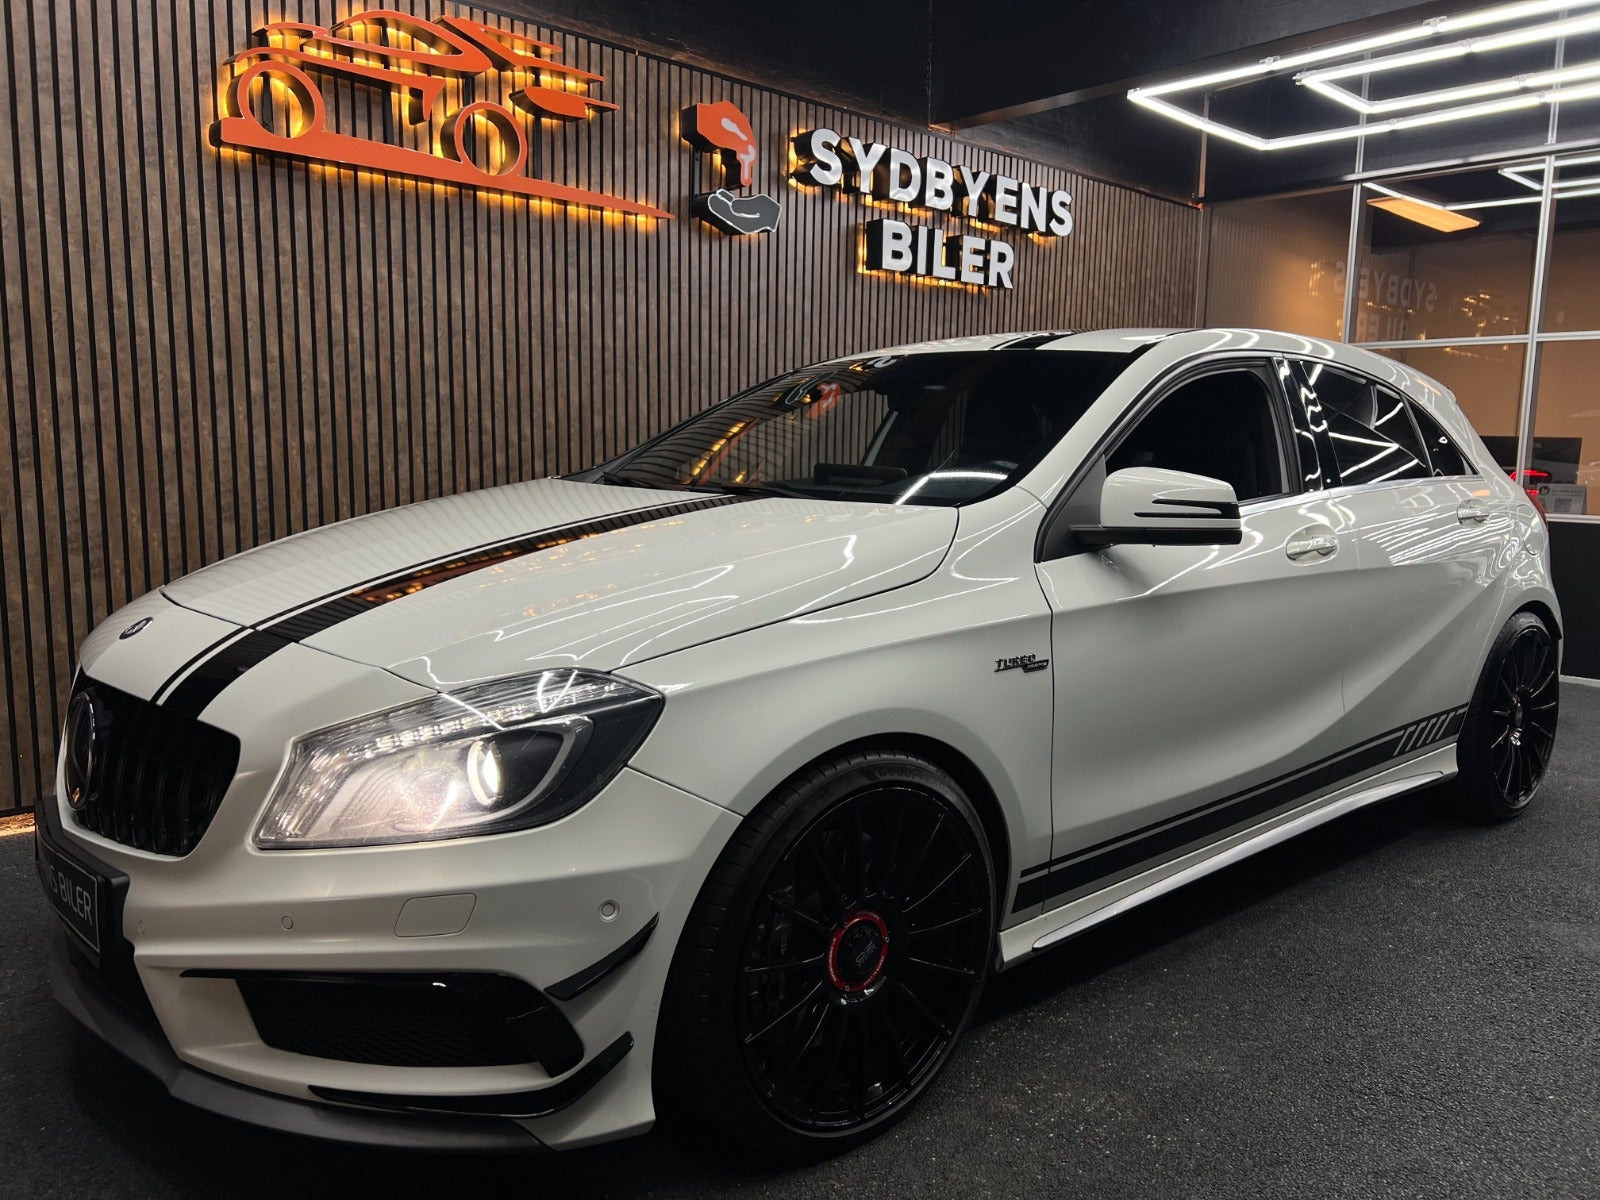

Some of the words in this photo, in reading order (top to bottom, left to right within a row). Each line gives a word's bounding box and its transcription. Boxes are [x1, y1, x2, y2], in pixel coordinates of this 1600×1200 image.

[809, 127, 1074, 238] SYDBYENS
[881, 218, 1015, 290] BILER
[57, 871, 93, 925] BILER
